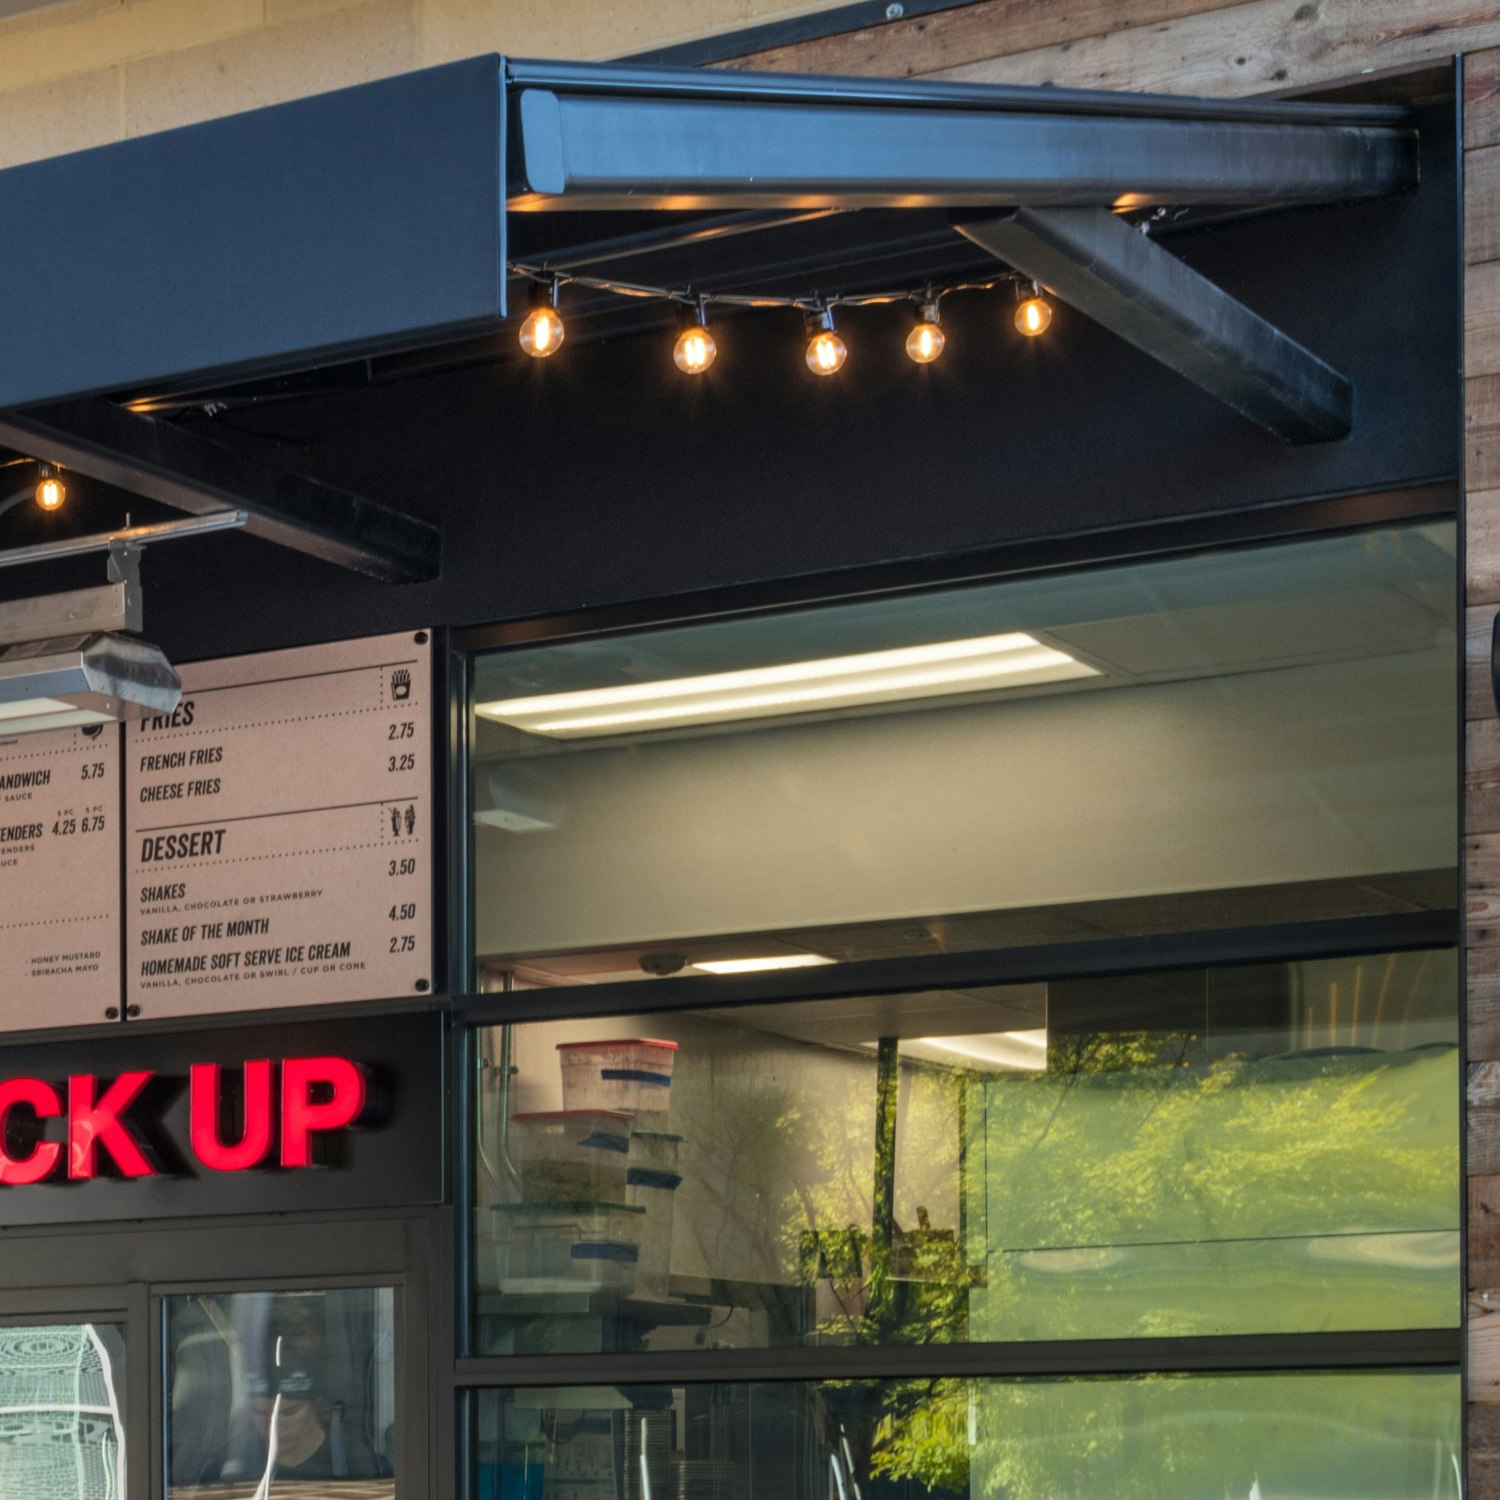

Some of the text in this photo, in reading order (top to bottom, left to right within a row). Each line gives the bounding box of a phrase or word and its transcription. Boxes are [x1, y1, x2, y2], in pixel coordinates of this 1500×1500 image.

[388, 722, 414, 740] 2.75
[140, 747, 223, 772] FRENCH FRIES
[388, 754, 415, 772] 3.25
[81, 762, 104, 780] 5.75
[4, 792, 32, 802] SAUCE
[140, 778, 221, 803] CHEESE FRIES
[52, 816, 105, 836] 4.25 6.75
[141, 829, 226, 863] DESSERT
[388, 858, 416, 876] 3.50
[140, 883, 186, 903] SHAKES
[140, 890, 322, 915] VANILLA, CHOCOLATE OR STRAWBERRY
[389, 903, 416, 921] 4.50
[141, 918, 269, 946] SHAKE OF THE MONTH
[389, 935, 415, 953] 2.75
[31, 951, 101, 964] HONEY MUSTARD
[141, 942, 351, 976] HOMEMADE SOFT SERVE ICE CREAM
[32, 964, 98, 977] SRIRACHA MAYO
[140, 979, 181, 989] VANILLA,
[185, 973, 239, 986] CHOCOLATE
[243, 972, 256, 980] OR
[260, 969, 288, 978] SWIRL
[300, 966, 319, 975] CUP
[322, 964, 336, 972] OR
[339, 962, 365, 971] CONE
[190, 1055, 363, 1172] UP
